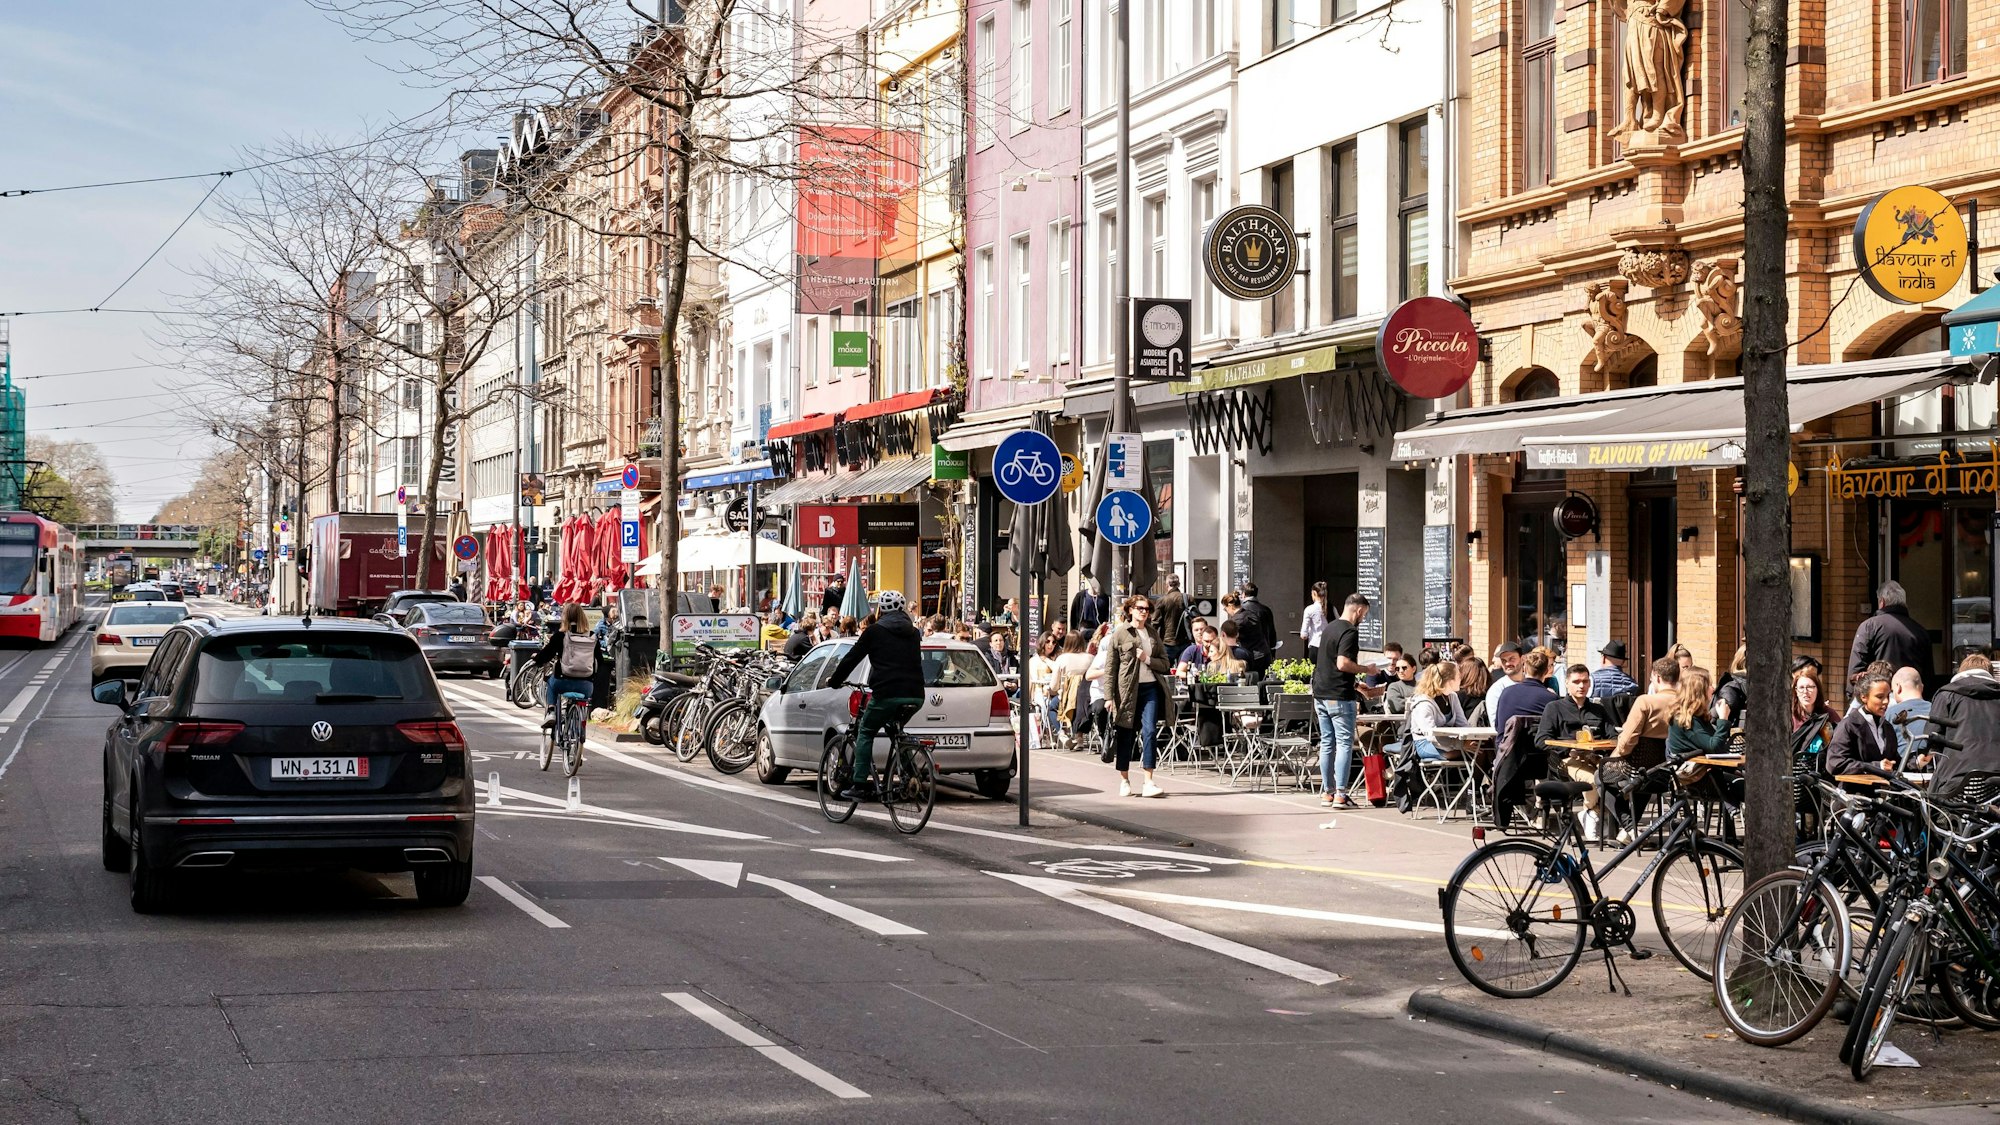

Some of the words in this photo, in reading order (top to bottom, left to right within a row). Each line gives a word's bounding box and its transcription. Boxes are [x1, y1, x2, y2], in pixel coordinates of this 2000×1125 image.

[1222, 219, 1286, 256] BALTHASAR
[1876, 245, 1936, 267] flavour
[1941, 249, 1957, 268] of
[807, 275, 842, 284] THEATER
[846, 276, 855, 285] IM
[859, 276, 899, 286] BAUTURM
[1238, 273, 1249, 283] BAR
[1250, 264, 1280, 285] RESTAURANT
[1898, 269, 1936, 290] india
[1392, 327, 1468, 354] Piccola
[1140, 358, 1167, 367] ASIATISCHE
[1143, 349, 1167, 357] MODERNE
[1151, 367, 1167, 376] KÜCHE
[1225, 363, 1266, 383] BALTHASAR
[1589, 446, 1645, 465] FLAVOUR
[1649, 446, 1665, 463] OF
[1669, 441, 1708, 461] INDIA
[1828, 453, 1914, 499] flavour
[1925, 450, 1949, 495] of
[729, 511, 763, 520] SALN
[624, 523, 635, 544] P
[943, 735, 966, 745] 1621
[280, 760, 301, 775] WN
[312, 760, 341, 775] 131
[346, 760, 356, 774] A
